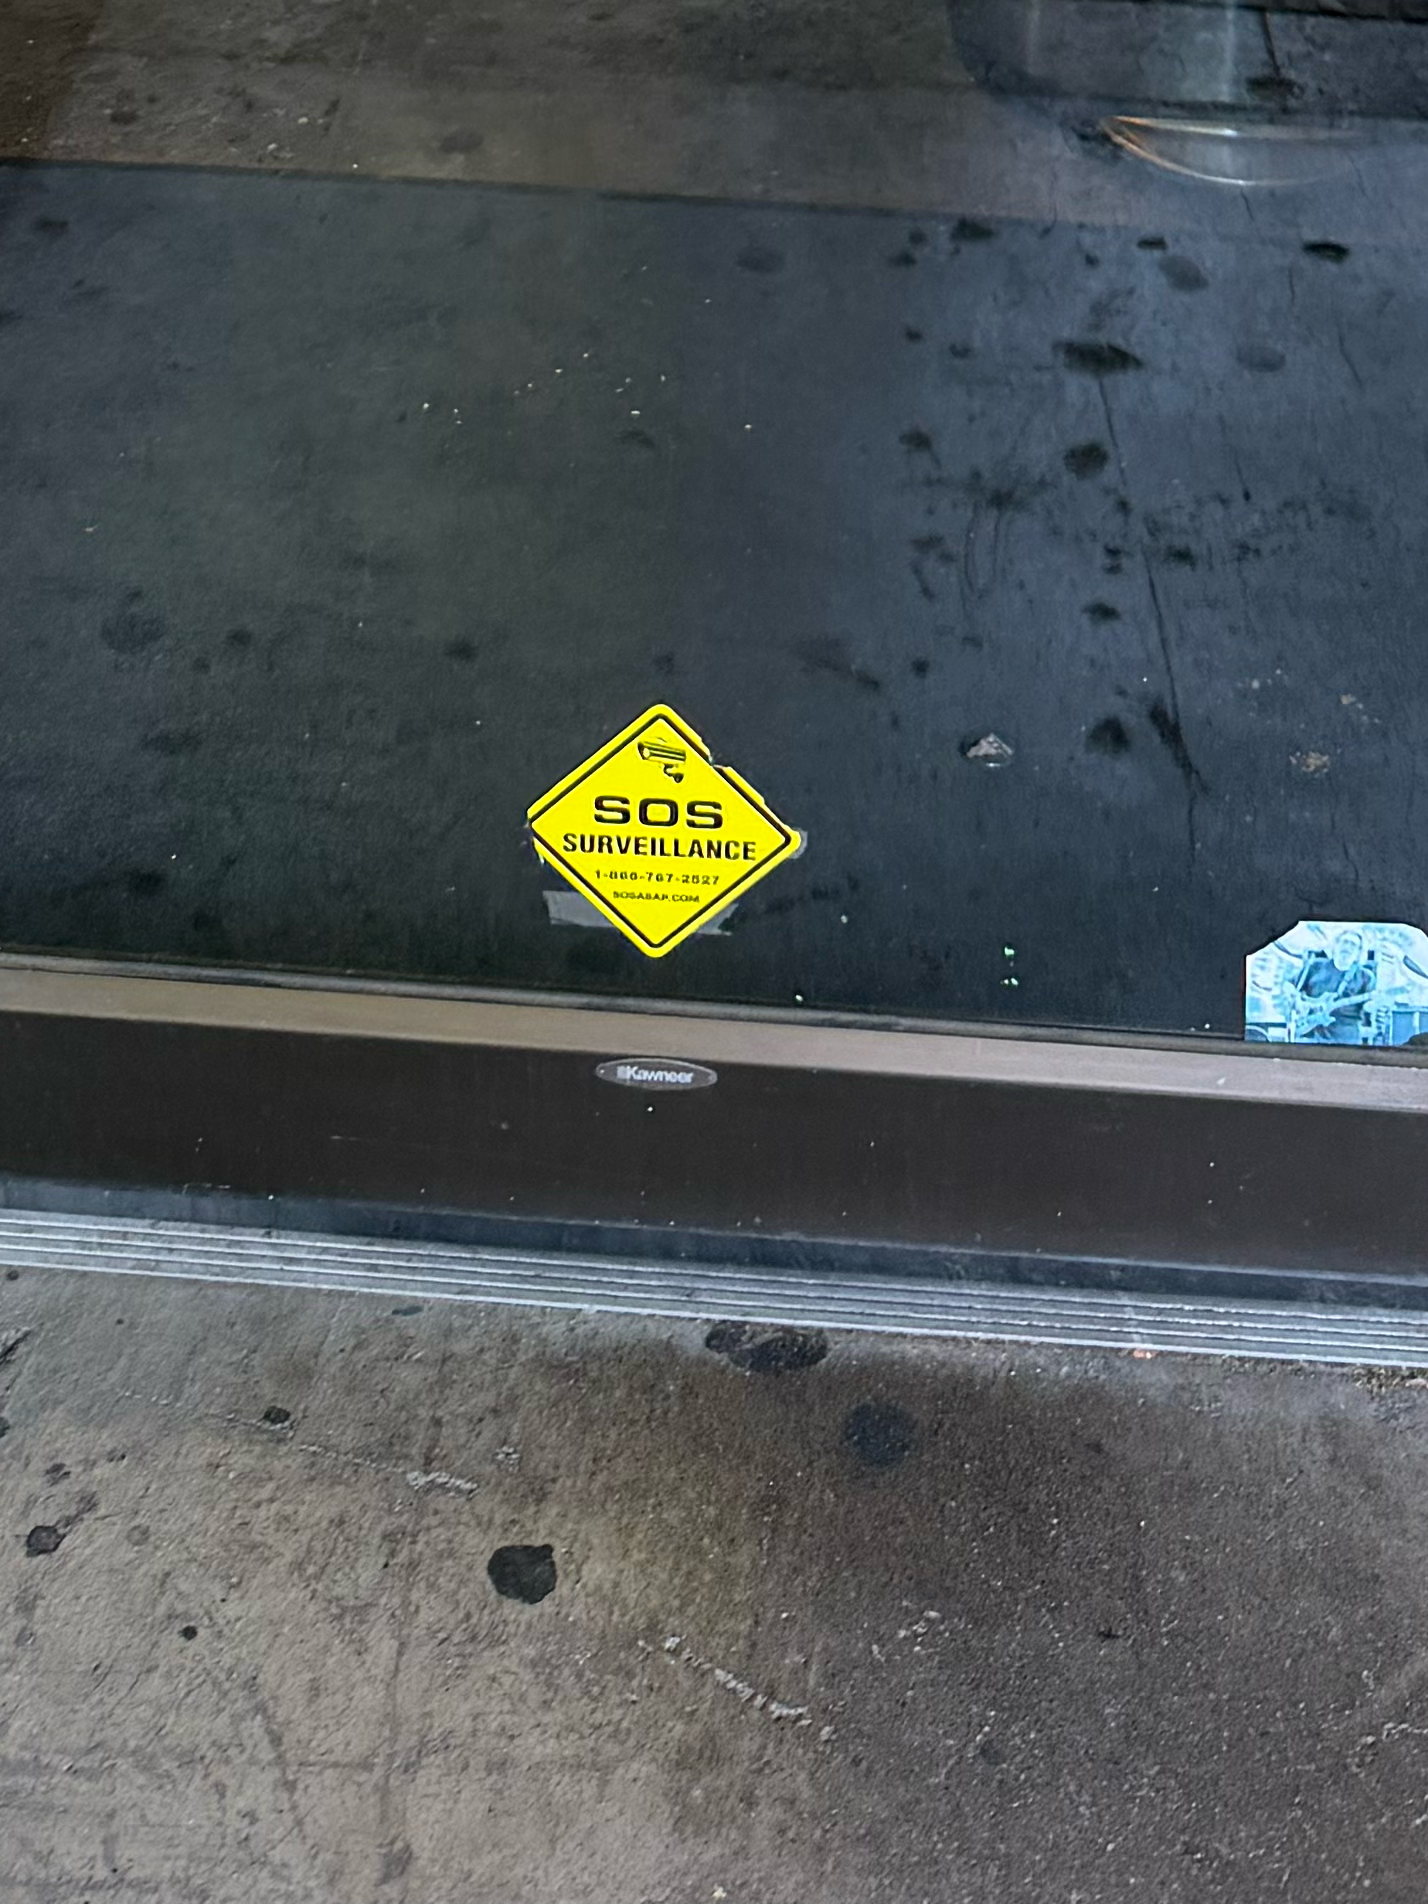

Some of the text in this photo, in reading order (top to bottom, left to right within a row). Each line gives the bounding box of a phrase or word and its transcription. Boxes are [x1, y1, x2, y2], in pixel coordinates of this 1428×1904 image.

[594, 795, 724, 830] SOS
[562, 832, 757, 861] SURVEILLANCE
[628, 1065, 694, 1084] Kawneer
